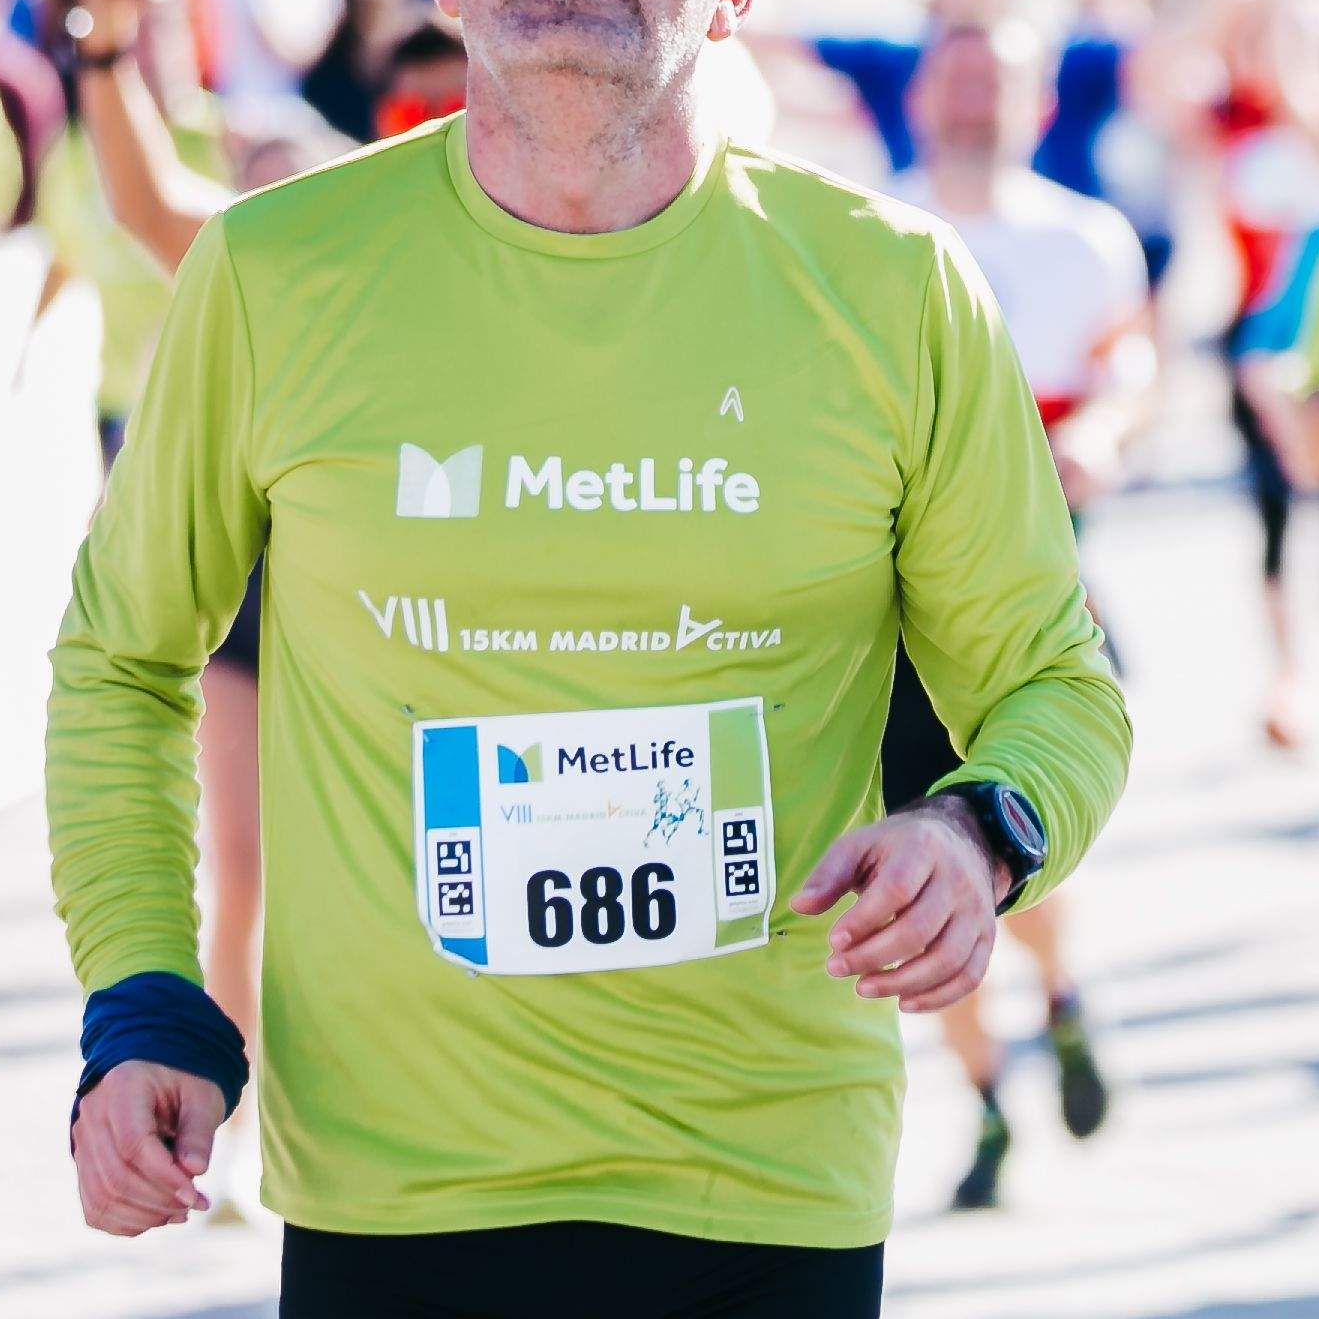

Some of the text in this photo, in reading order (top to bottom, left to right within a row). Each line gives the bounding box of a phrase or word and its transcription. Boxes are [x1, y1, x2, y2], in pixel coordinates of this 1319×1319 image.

[505, 454, 761, 513] MetLife
[357, 589, 449, 652] VIII
[459, 628, 538, 652] 15KM
[548, 629, 671, 652] MADRID
[557, 740, 695, 775] MetLife
[500, 804, 533, 824] VIII
[526, 861, 678, 948] 686
